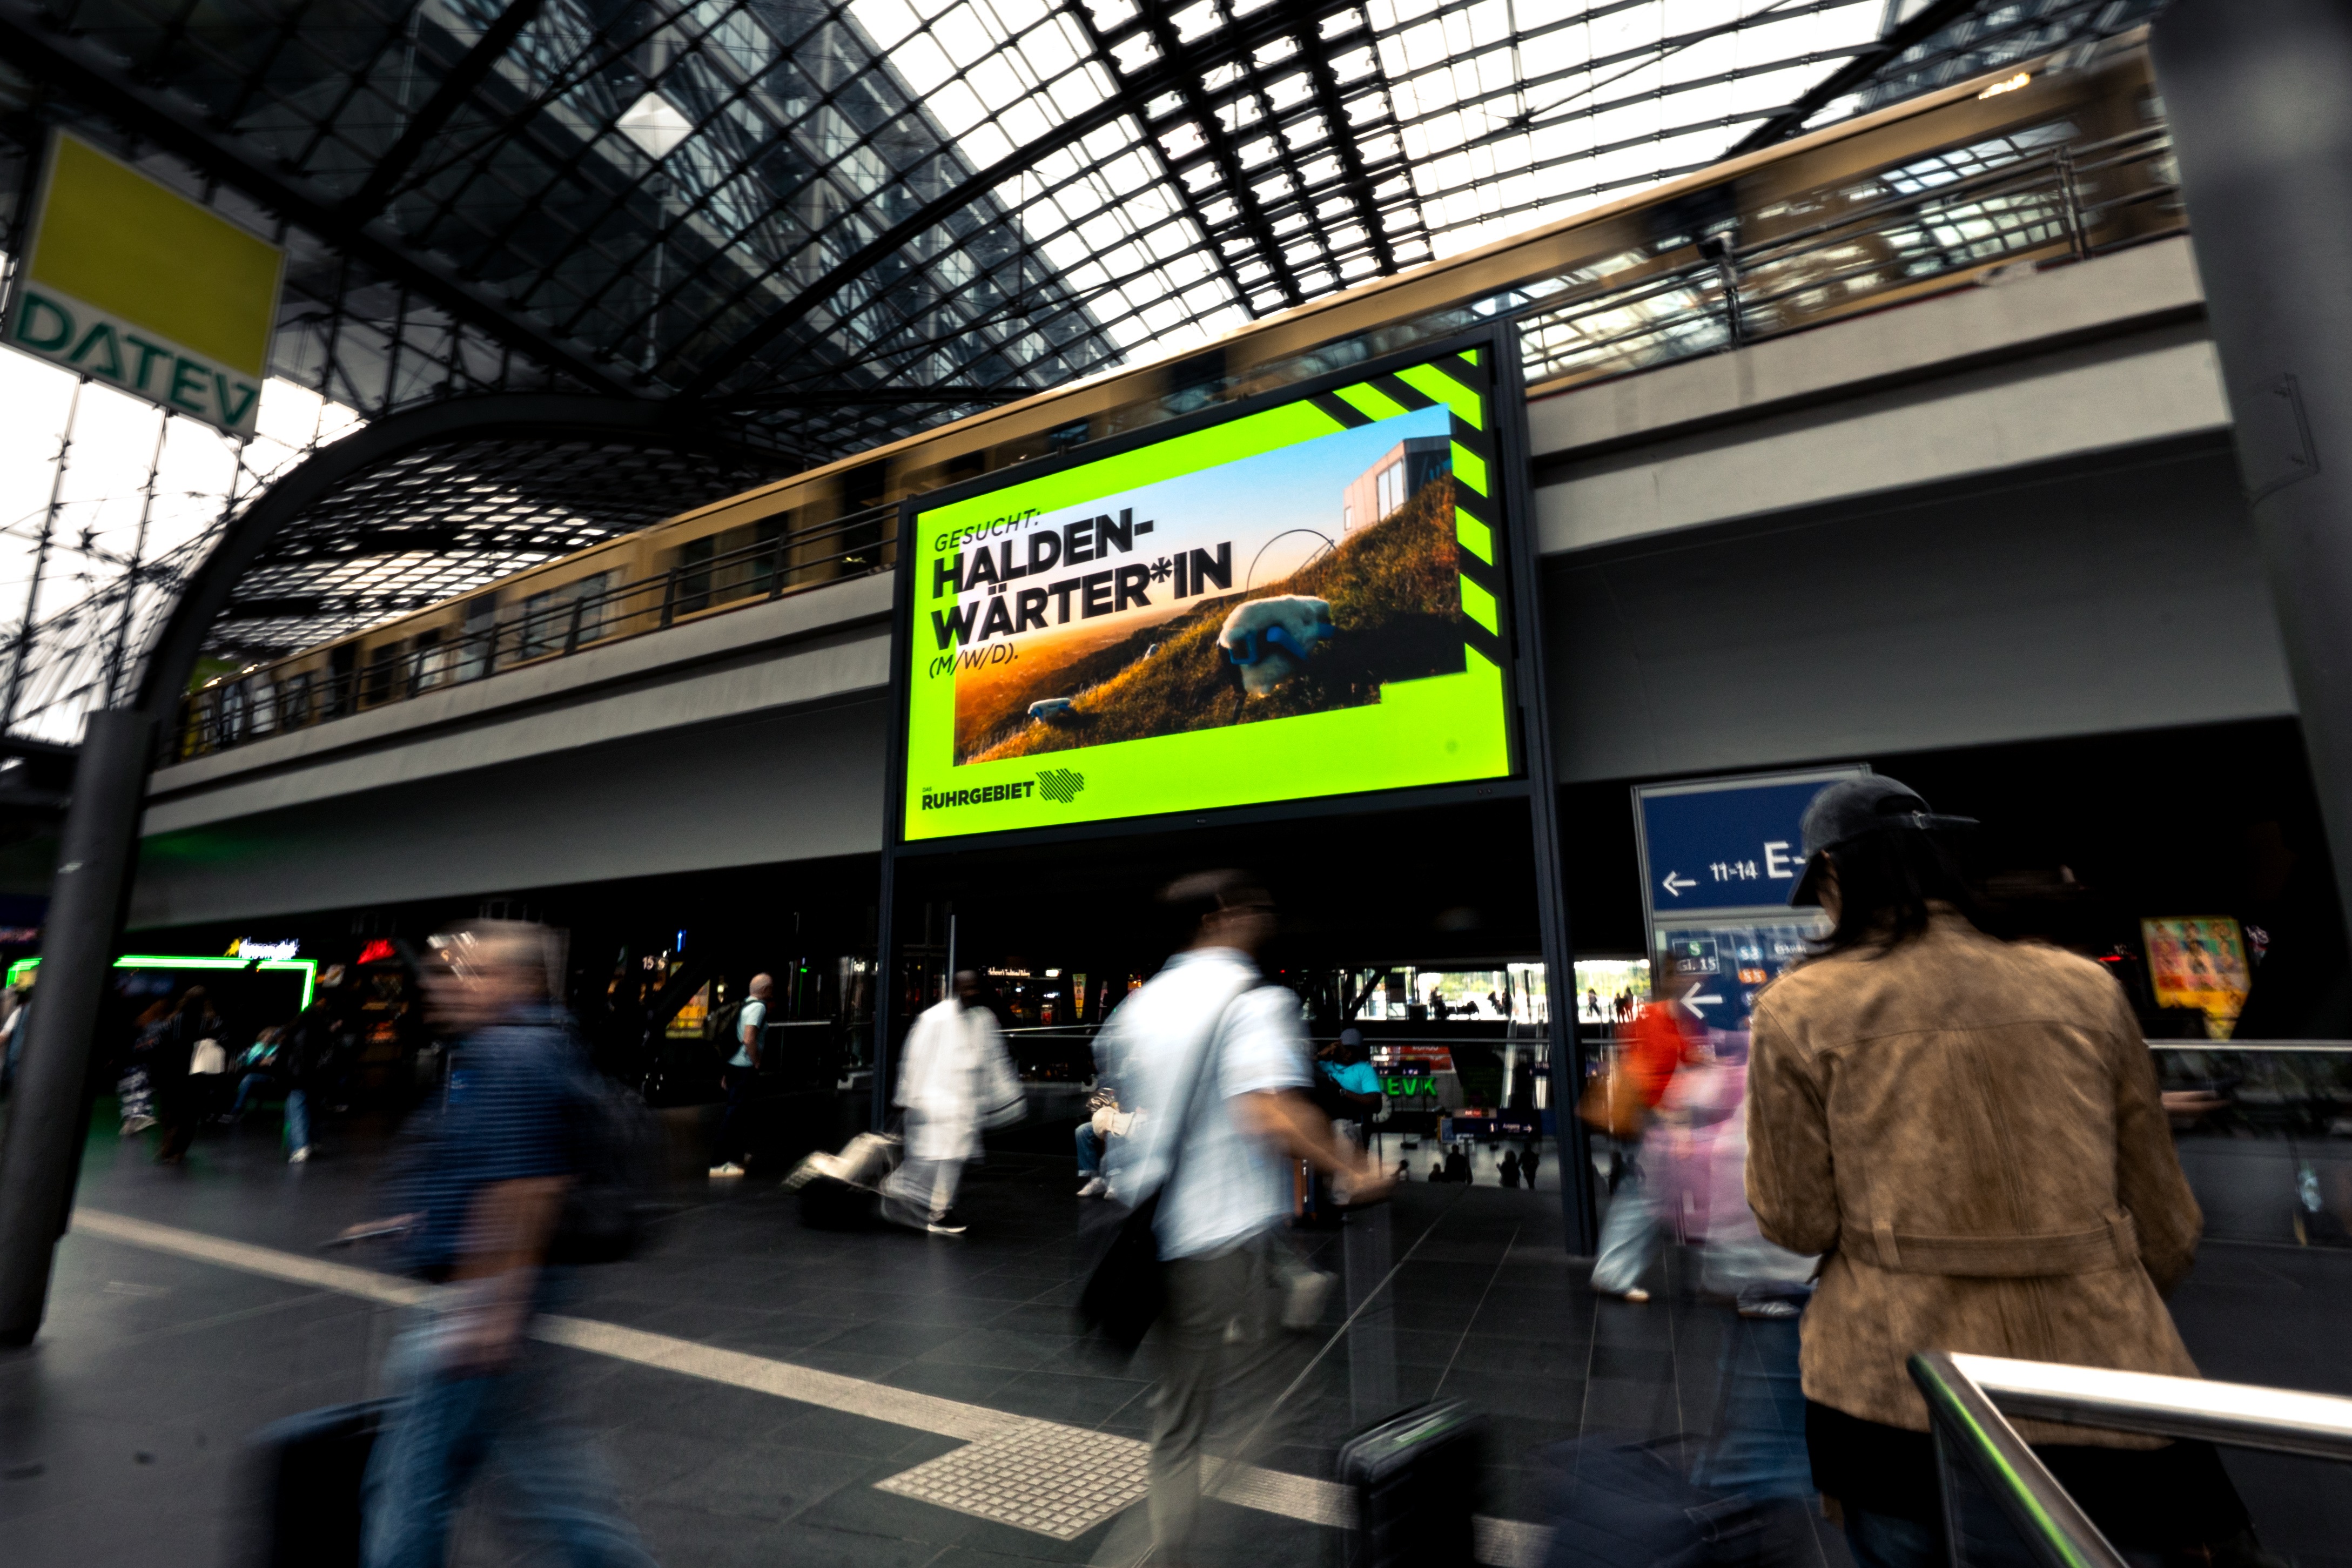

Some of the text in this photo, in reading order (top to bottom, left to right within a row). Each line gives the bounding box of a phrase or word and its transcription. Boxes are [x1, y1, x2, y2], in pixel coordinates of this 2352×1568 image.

[14, 290, 258, 427] DATEV
[935, 508, 1041, 551] GESUCHT:
[932, 507, 1154, 600] HALDEN-
[929, 643, 1018, 679] (M/W/D).
[922, 780, 1034, 810] RUHRGEBIET
[1709, 859, 1758, 881] 11-14
